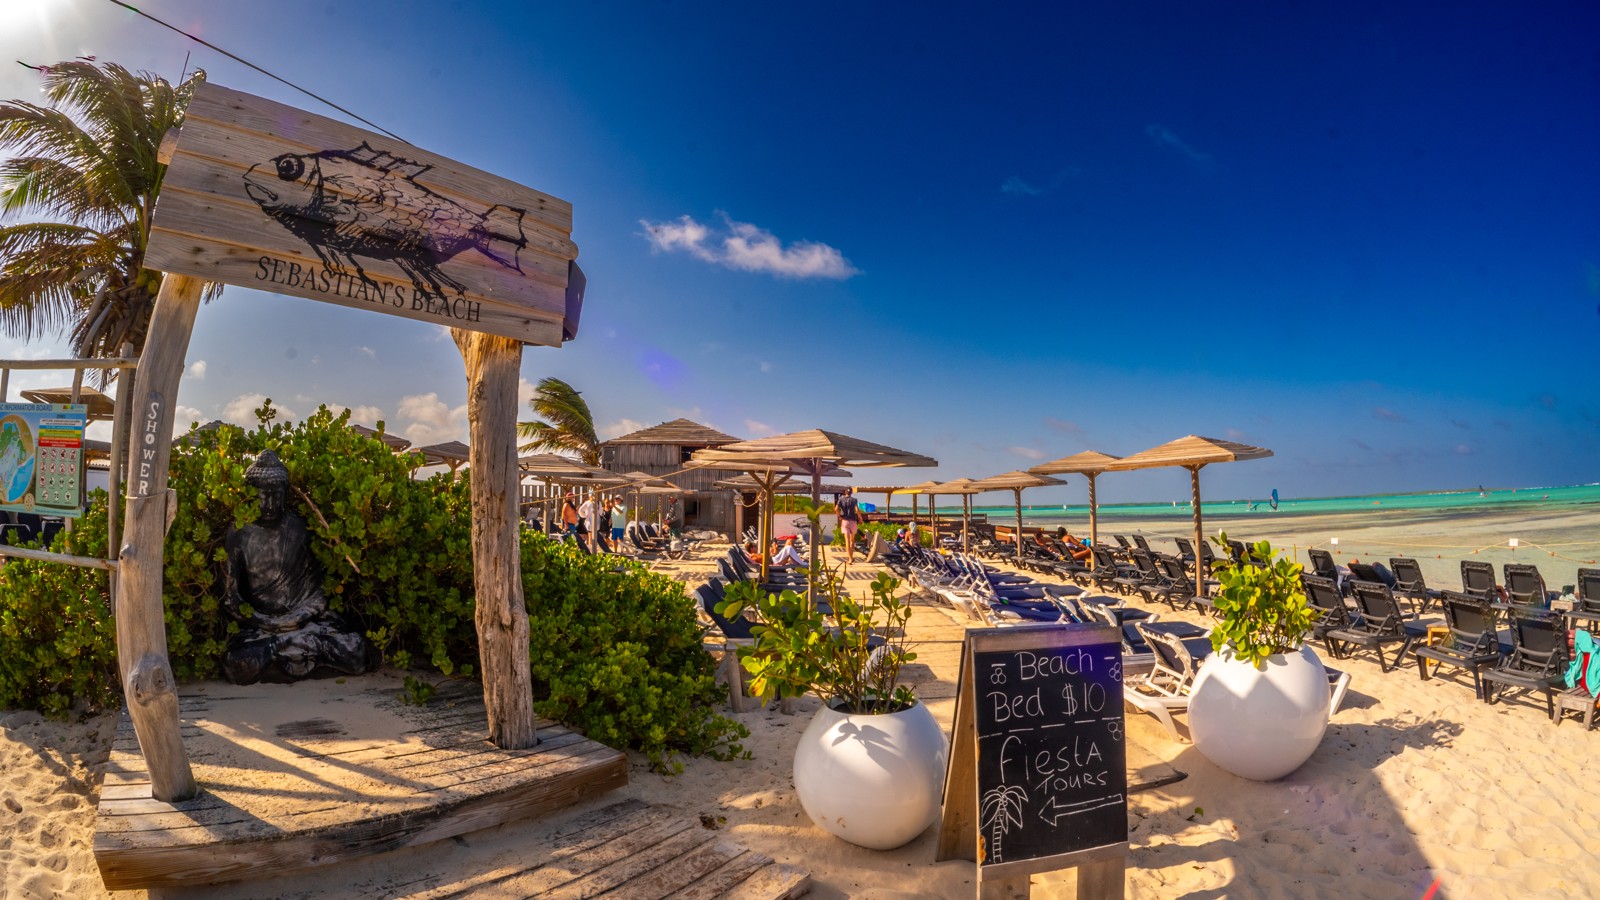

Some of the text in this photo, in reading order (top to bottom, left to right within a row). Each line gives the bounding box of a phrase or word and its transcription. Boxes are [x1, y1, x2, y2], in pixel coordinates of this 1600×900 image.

[255, 256, 481, 323] SEBASTIAN'S BEACH
[138, 402, 160, 495] SHOWER
[1014, 649, 1093, 680] Beach
[986, 682, 1106, 722] Bed $10
